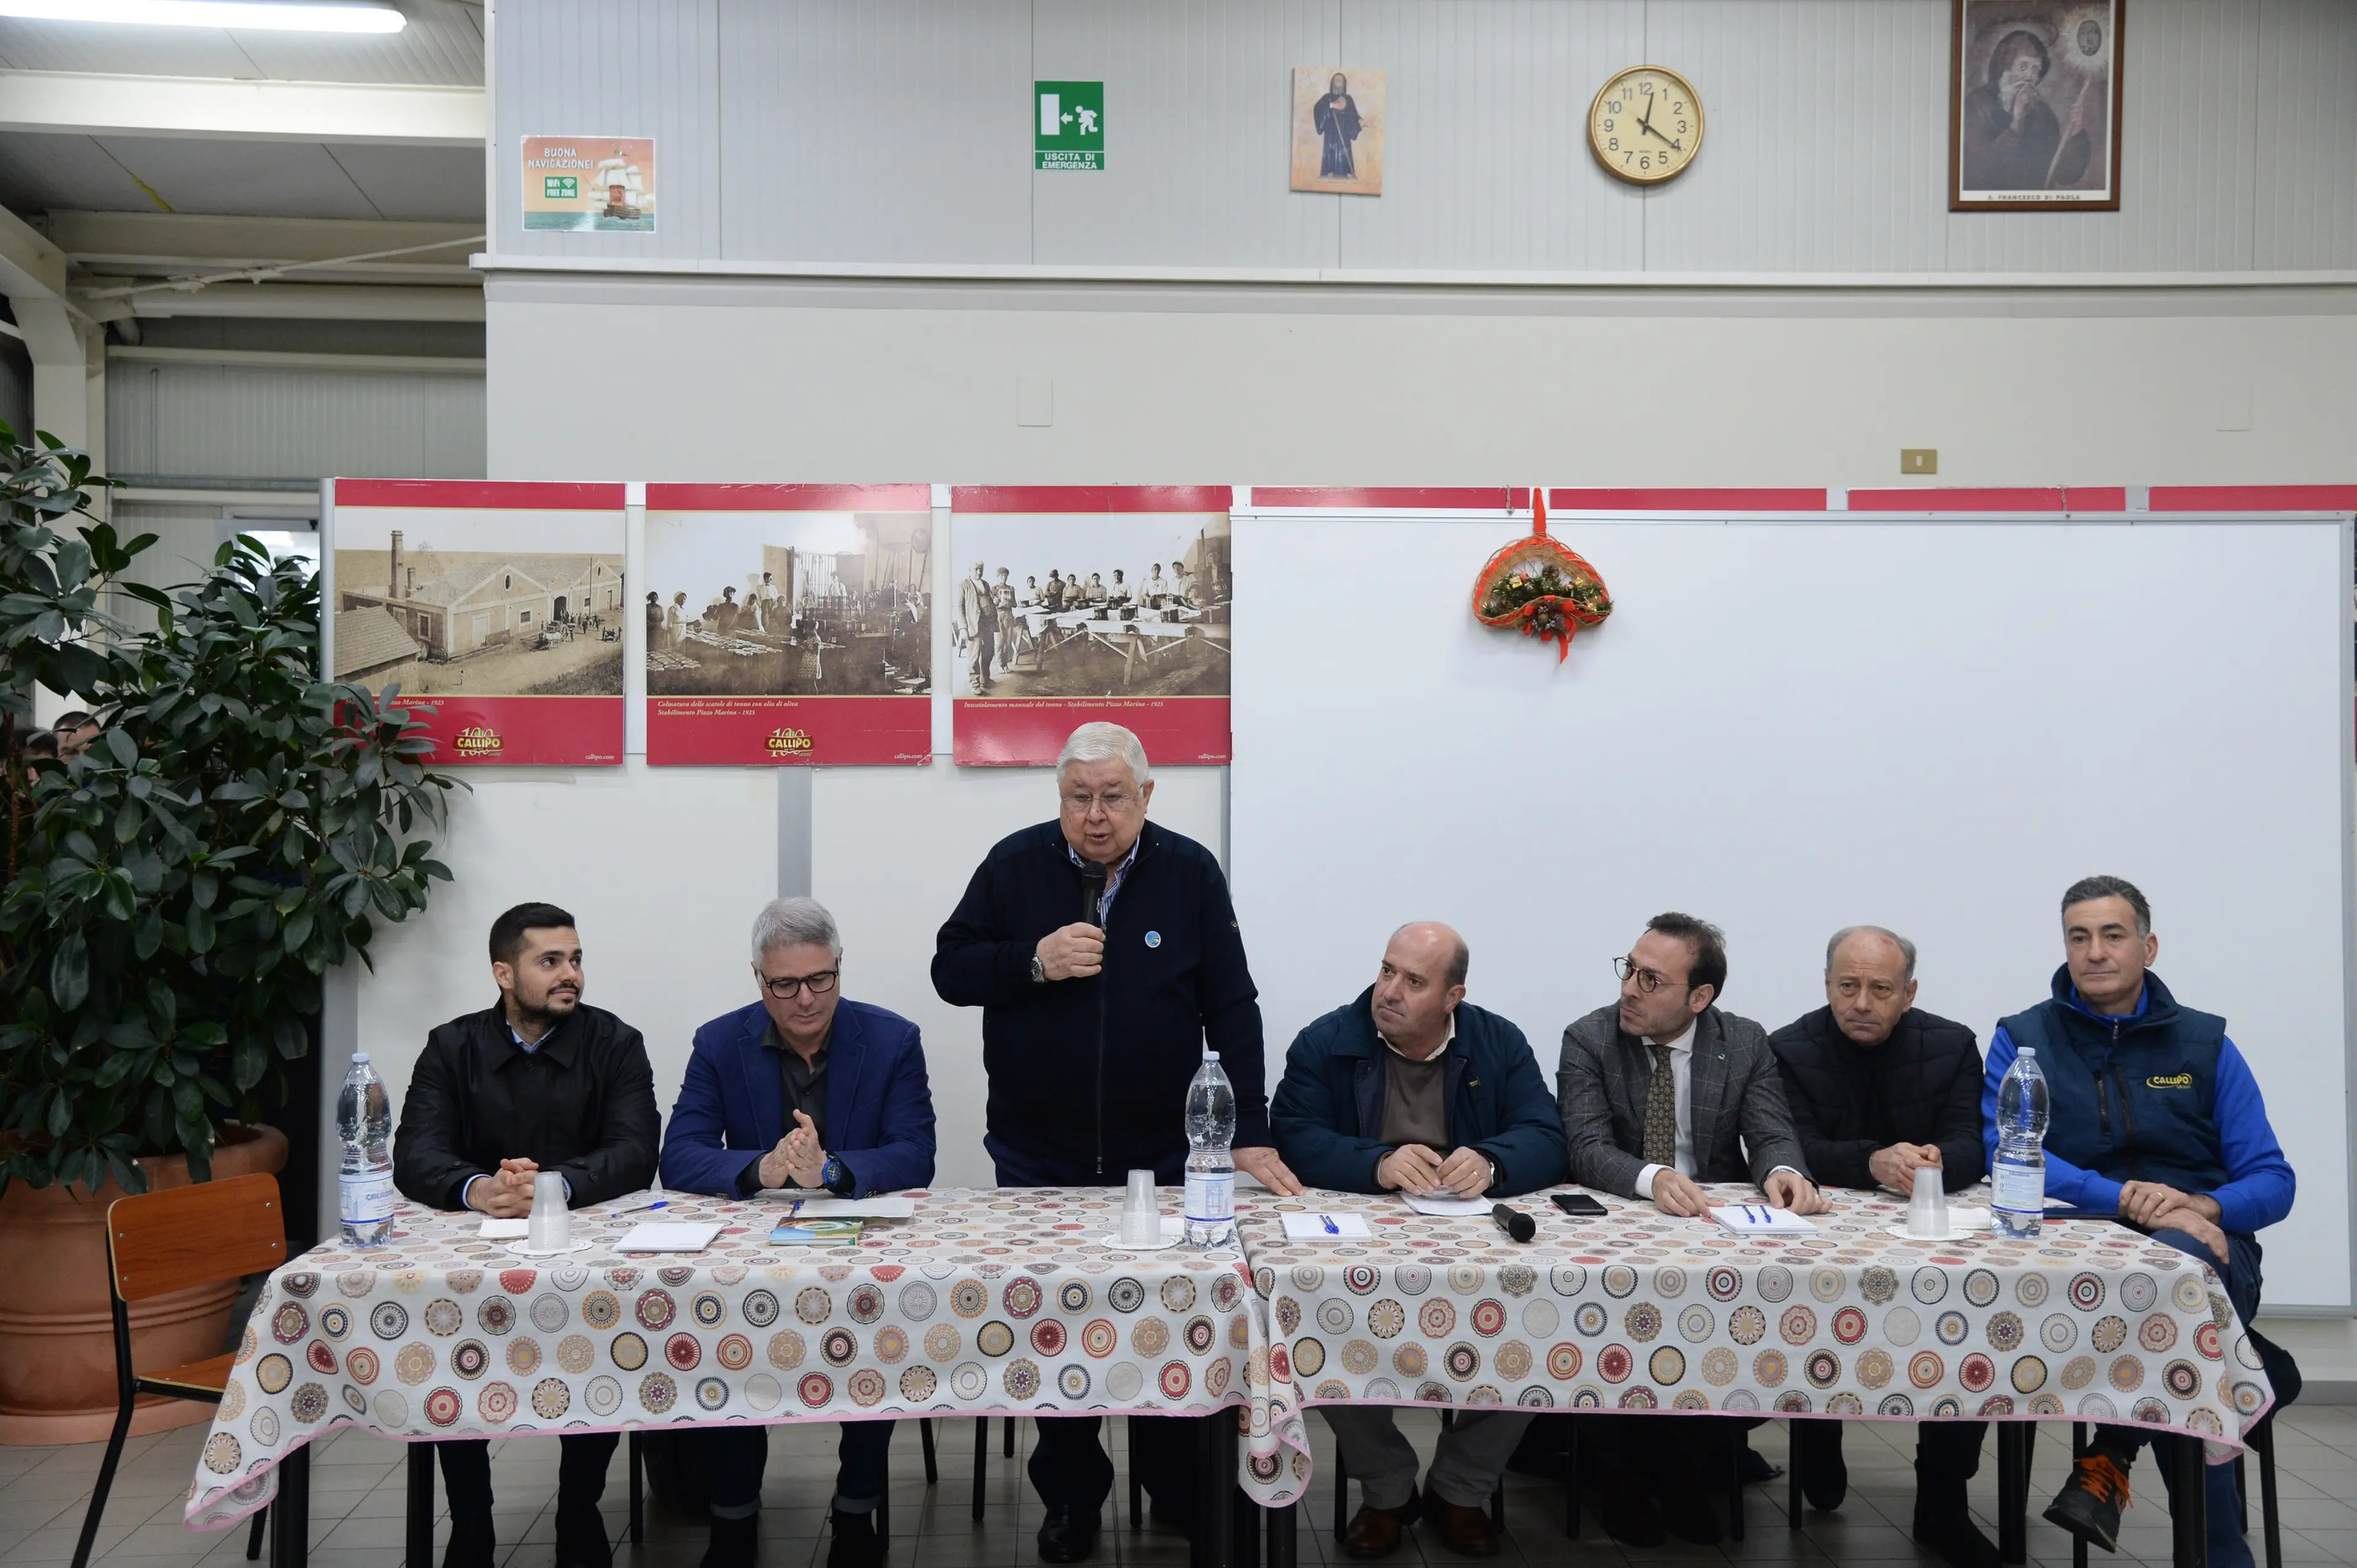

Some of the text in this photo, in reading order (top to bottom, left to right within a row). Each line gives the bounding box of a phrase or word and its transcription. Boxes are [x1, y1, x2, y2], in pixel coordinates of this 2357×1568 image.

[1622, 87, 1633, 100] 11
[1638, 82, 1652, 95] 12
[1662, 88, 1668, 101] 1
[1607, 101, 1622, 114] 10
[1673, 101, 1682, 114] 2
[1603, 119, 1614, 132] 9
[1677, 120, 1687, 134] 3
[1609, 137, 1619, 151] 8
[1671, 139, 1681, 151] 4
[544, 148, 577, 157] BUONA
[1624, 151, 1633, 164] 7
[1658, 151, 1668, 164] 5
[528, 160, 594, 169] NAVIGAZIONE!
[1640, 156, 1650, 169] 6
[457, 737, 501, 748] CALLIPO
[768, 738, 811, 748] CALLIPO
